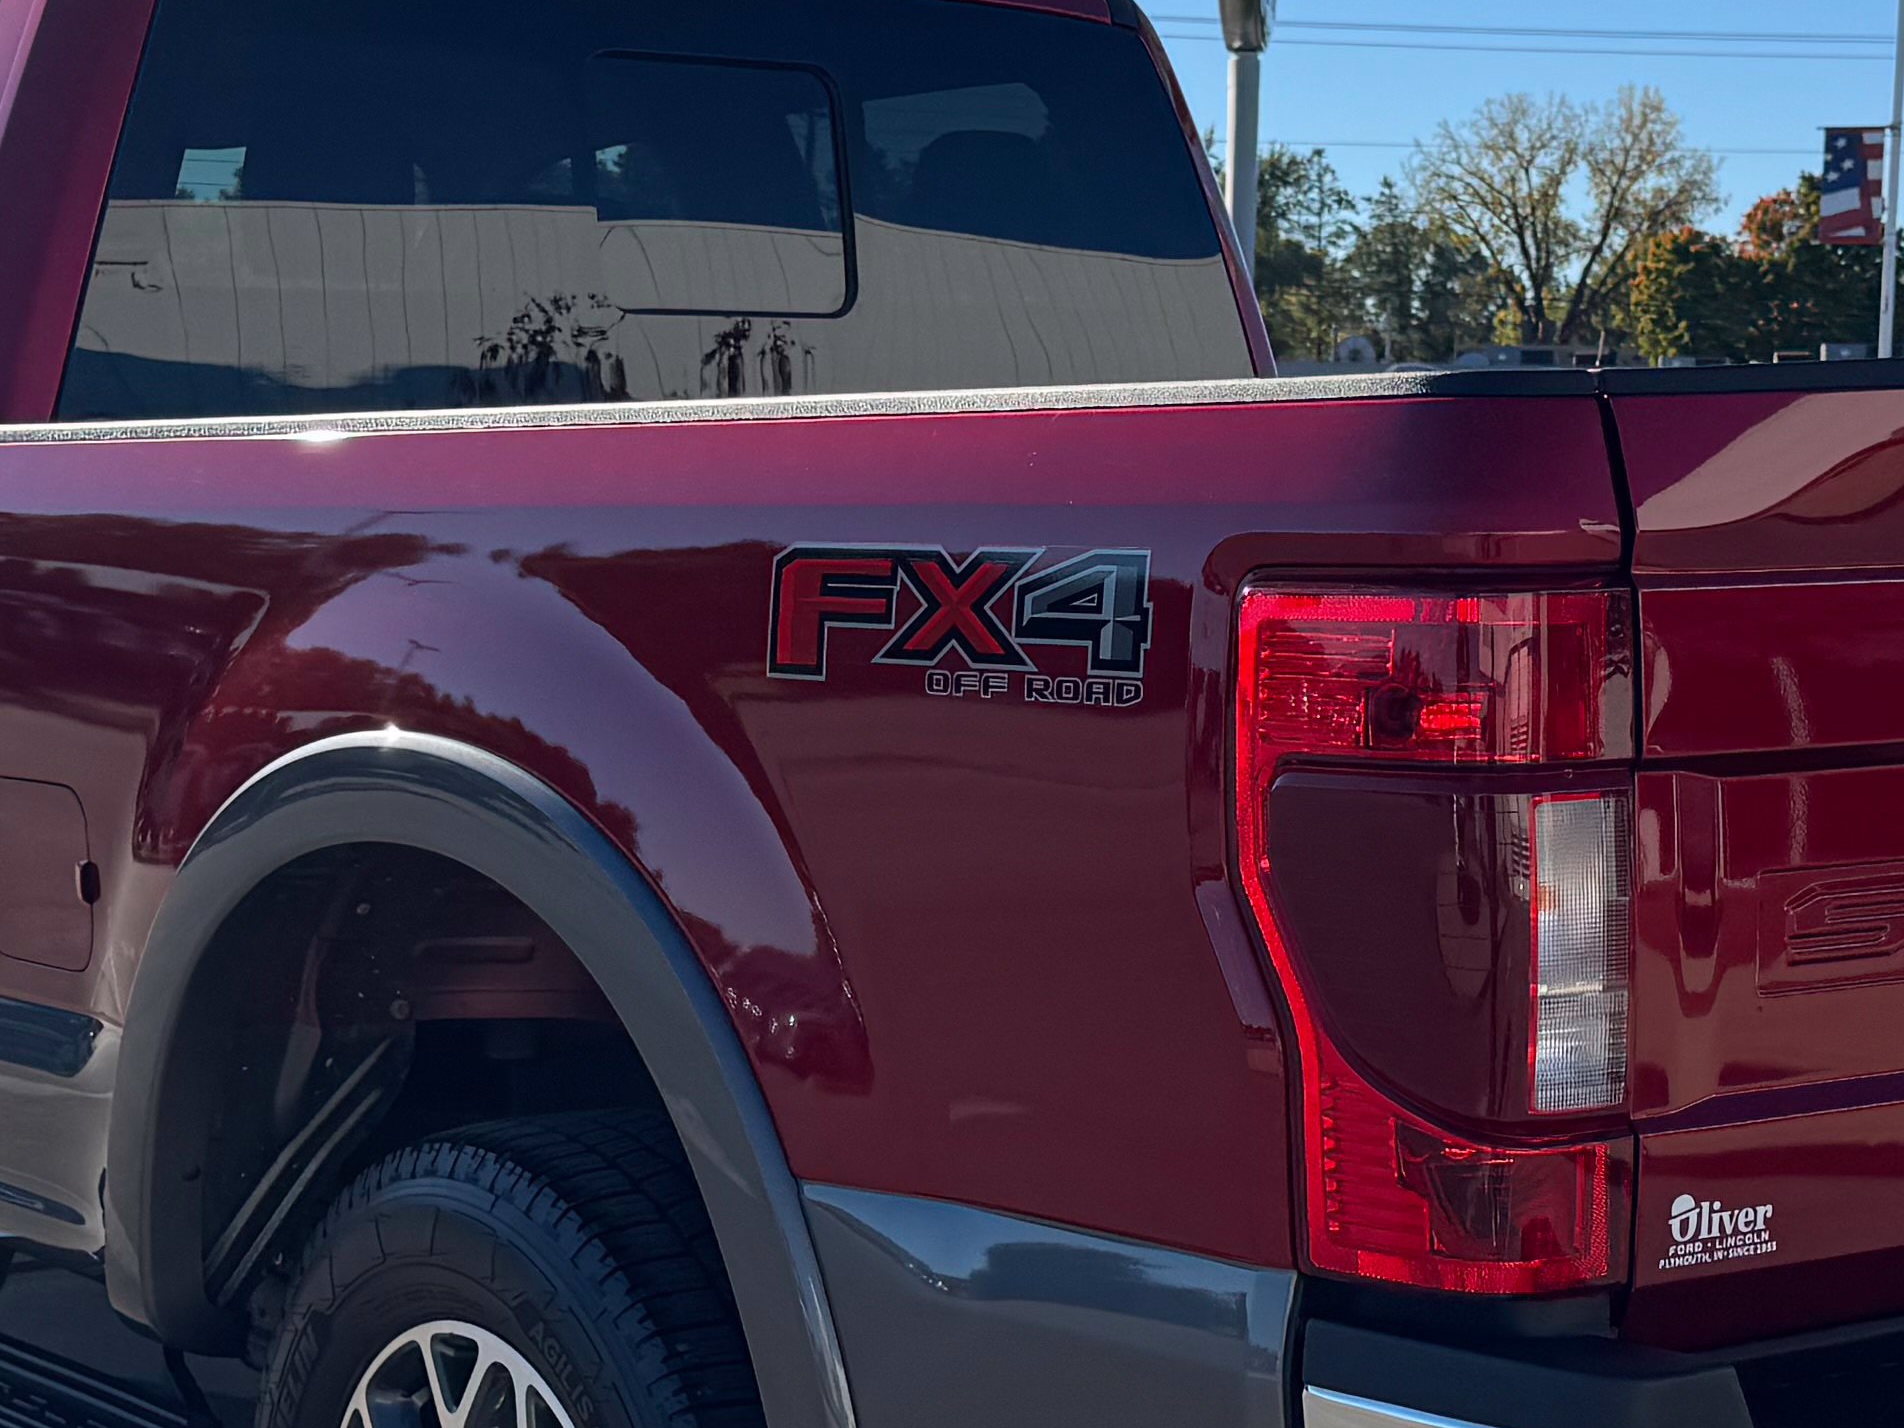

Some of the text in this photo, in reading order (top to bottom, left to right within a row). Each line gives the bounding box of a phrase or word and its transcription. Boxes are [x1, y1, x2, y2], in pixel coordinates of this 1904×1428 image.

[766, 541, 1153, 681] FX4
[925, 669, 1144, 707] OFF ROAD
[1668, 1193, 1774, 1243] Oliver
[1668, 1230, 1770, 1257] FORD LINCOLN
[528, 1320, 595, 1422] AGILIS
